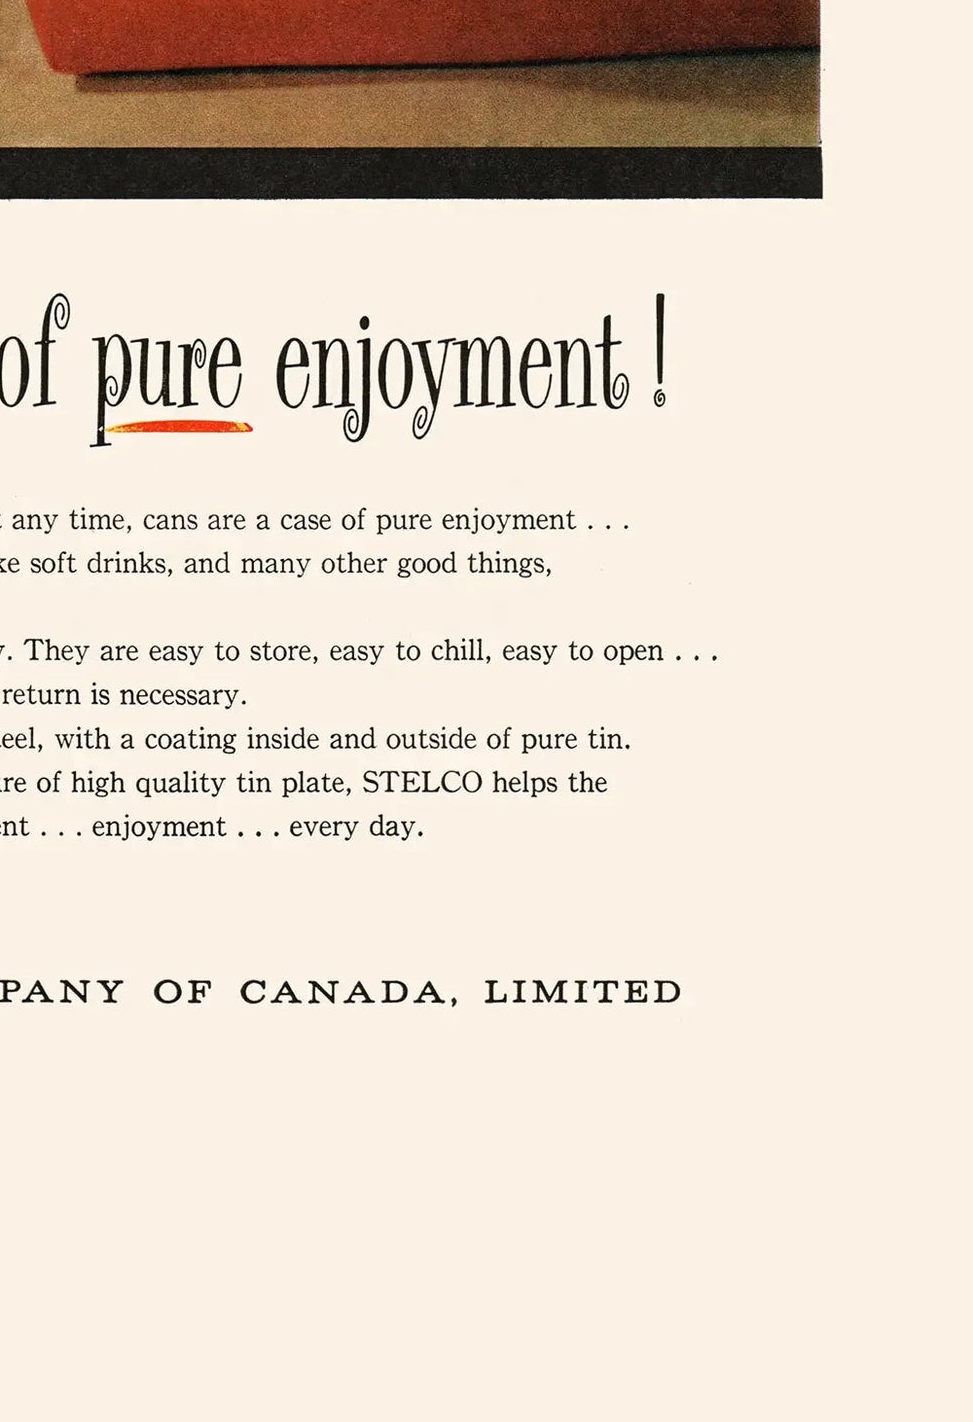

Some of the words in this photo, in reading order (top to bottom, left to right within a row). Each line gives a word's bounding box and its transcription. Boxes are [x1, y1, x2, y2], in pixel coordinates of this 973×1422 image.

[90, 334, 243, 447] pure
[12, 513, 59, 535] any
[68, 506, 132, 534] time,
[143, 513, 198, 531] cans
[207, 513, 246, 531] are
[256, 513, 271, 531] a
[280, 513, 332, 531] case
[341, 507, 367, 531] of
[375, 513, 433, 535] pure
[441, 507, 577, 535] enjoyment
[30, 550, 78, 574] soft
[87, 550, 173, 578] drinks,
[184, 551, 231, 574] and
[241, 557, 312, 578] many
[321, 551, 388, 574] other
[397, 550, 458, 579] good
[467, 550, 552, 579] things,
[23, 638, 91, 666] They
[100, 644, 139, 662] are
[148, 644, 204, 666] easy
[214, 641, 240, 662] to
[250, 641, 318, 665] store,
[329, 644, 385, 666] easy
[395, 641, 421, 662] to
[431, 637, 491, 664] chill,
[502, 644, 558, 666] easy
[568, 641, 594, 662] to
[603, 644, 664, 666] open
[2, 684, 82, 705] return
[90, 681, 111, 706] is
[119, 688, 247, 710] necessary.
[54, 726, 111, 750] with
[120, 733, 135, 750] a
[144, 726, 237, 755] coating
[247, 726, 320, 750] inside
[329, 726, 377, 750] and
[386, 726, 477, 750] outside
[486, 726, 513, 750] of
[521, 733, 578, 755] pure
[587, 726, 631, 750] tin.
[36, 770, 63, 794] of
[71, 769, 126, 798] high
[135, 770, 227, 798] quality
[236, 770, 272, 793] tin
[281, 770, 352, 798] plate,
[362, 769, 483, 794] STELCO
[492, 770, 558, 798] helps
[567, 770, 608, 793] the
[92, 813, 227, 842] enjoyment
[289, 820, 360, 842] every
[369, 813, 424, 842] day.
[153, 978, 212, 1005] OF
[239, 979, 458, 1008] CANADA,
[484, 979, 681, 1004] LIMITED
